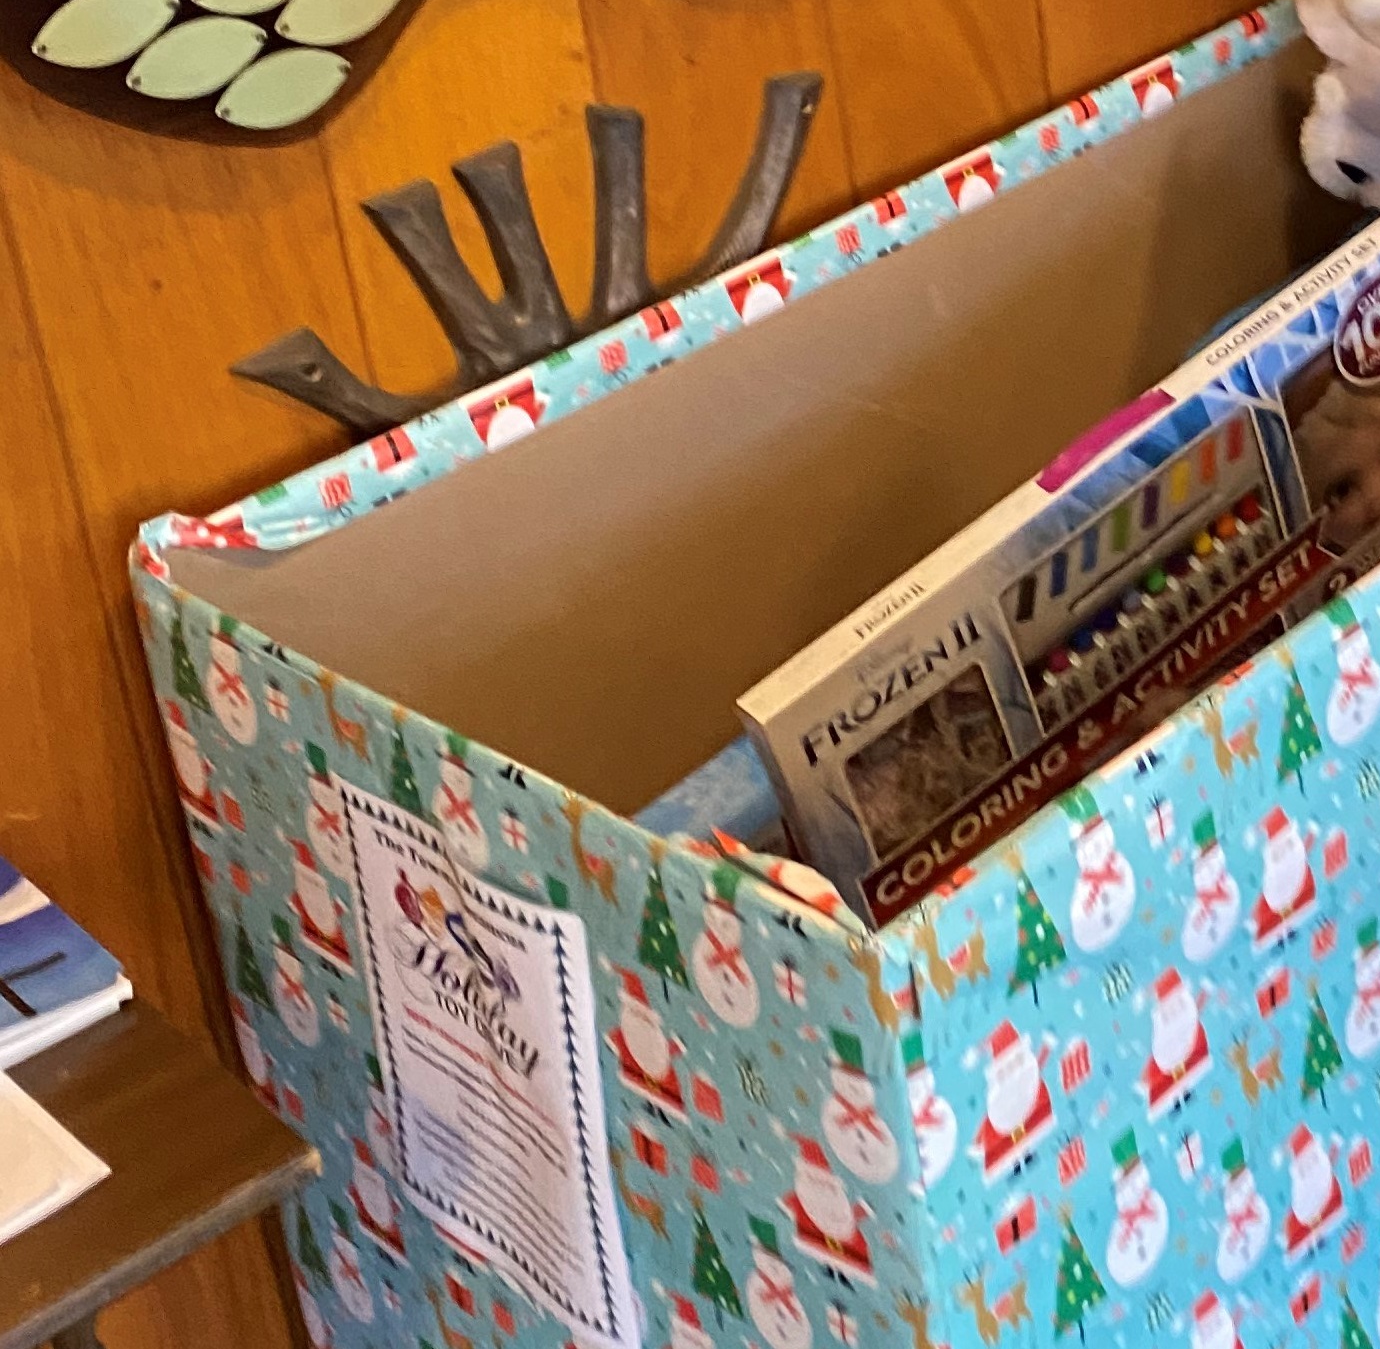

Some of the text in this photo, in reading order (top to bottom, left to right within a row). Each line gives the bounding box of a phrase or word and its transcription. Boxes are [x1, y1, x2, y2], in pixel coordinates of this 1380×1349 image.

[1206, 311, 1280, 366] COLORING
[1293, 254, 1352, 302] ACTIVITY
[801, 637, 949, 768] FROZEN
[949, 612, 981, 651] II
[875, 742, 1068, 906] COLORING
[1112, 589, 1250, 726] ACTIVITY
[1258, 539, 1312, 603] SET
[398, 932, 541, 1080] Holiday
[434, 988, 470, 1026] TOY
